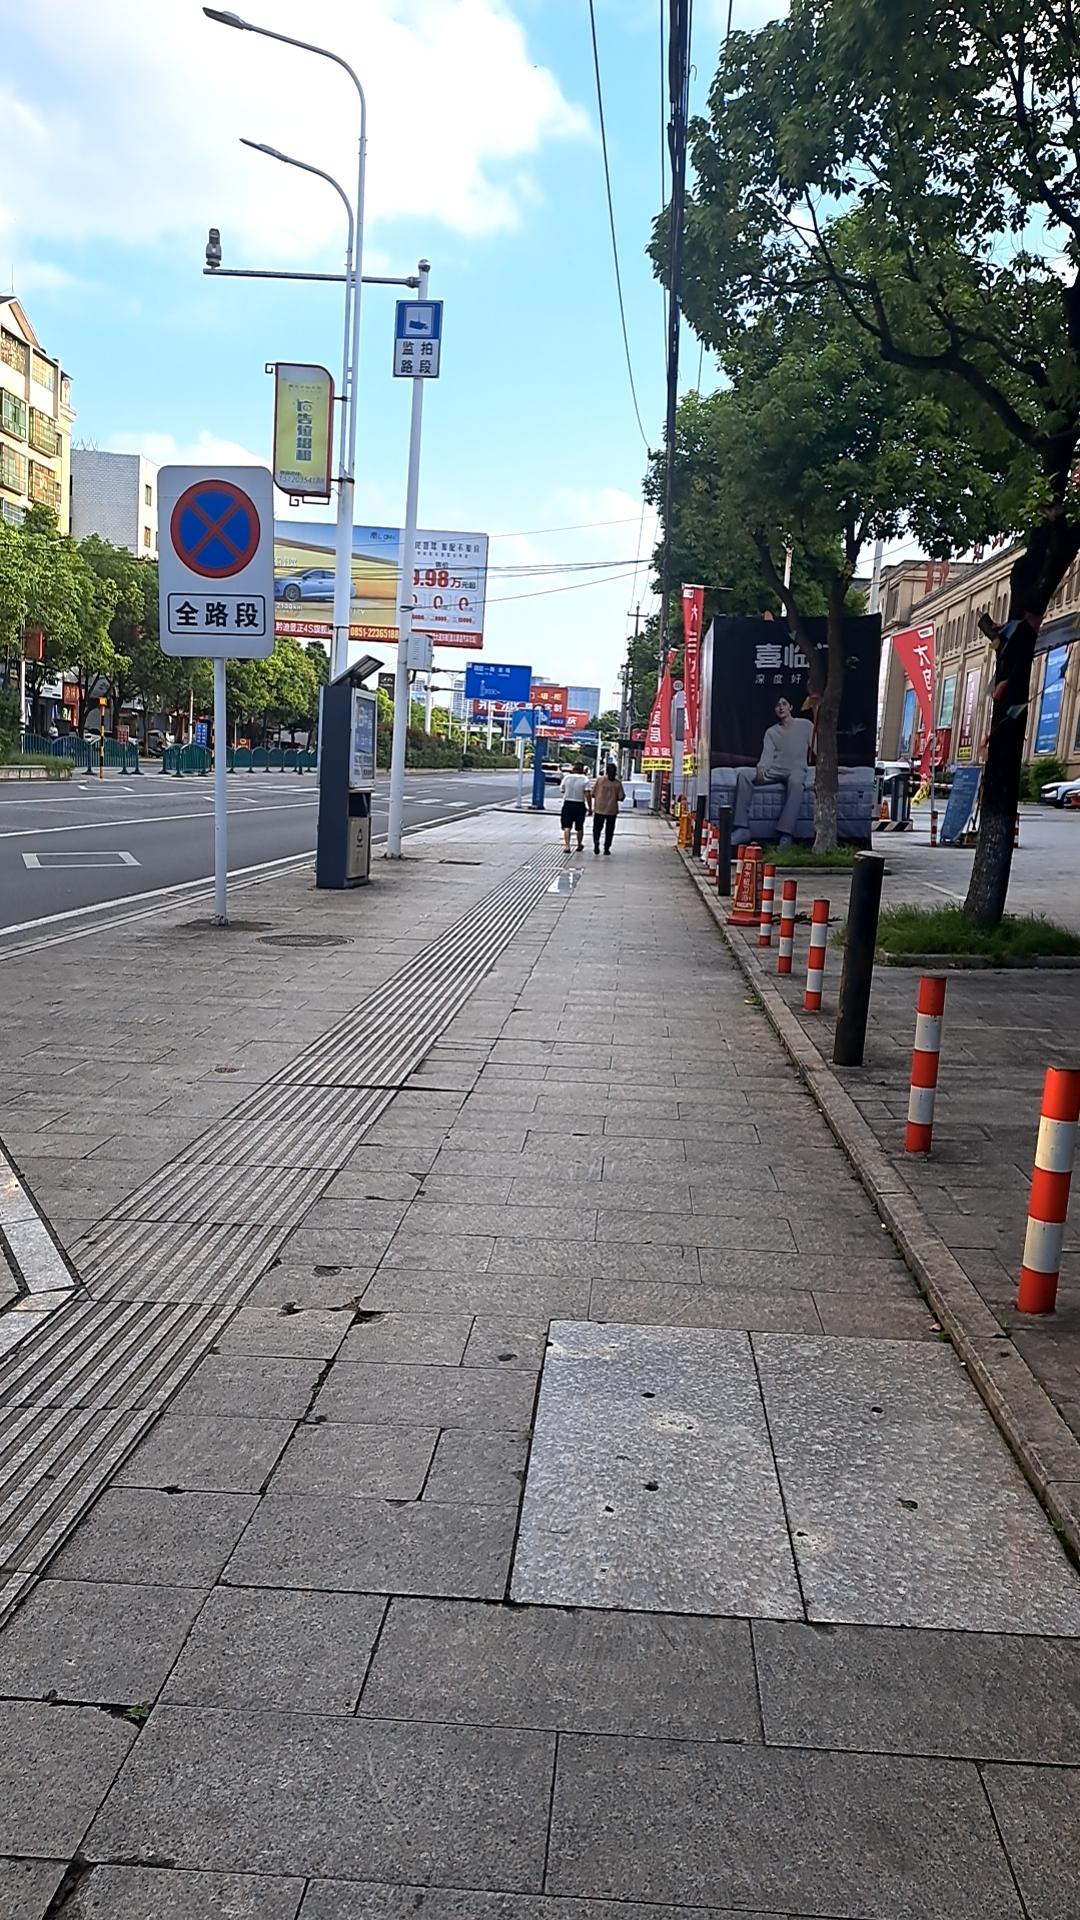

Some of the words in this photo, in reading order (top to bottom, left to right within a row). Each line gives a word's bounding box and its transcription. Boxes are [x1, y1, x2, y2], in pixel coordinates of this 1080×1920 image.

[402, 341, 433, 355] 监拍
[401, 360, 432, 373] 路段
[175, 601, 259, 628] 全路段
